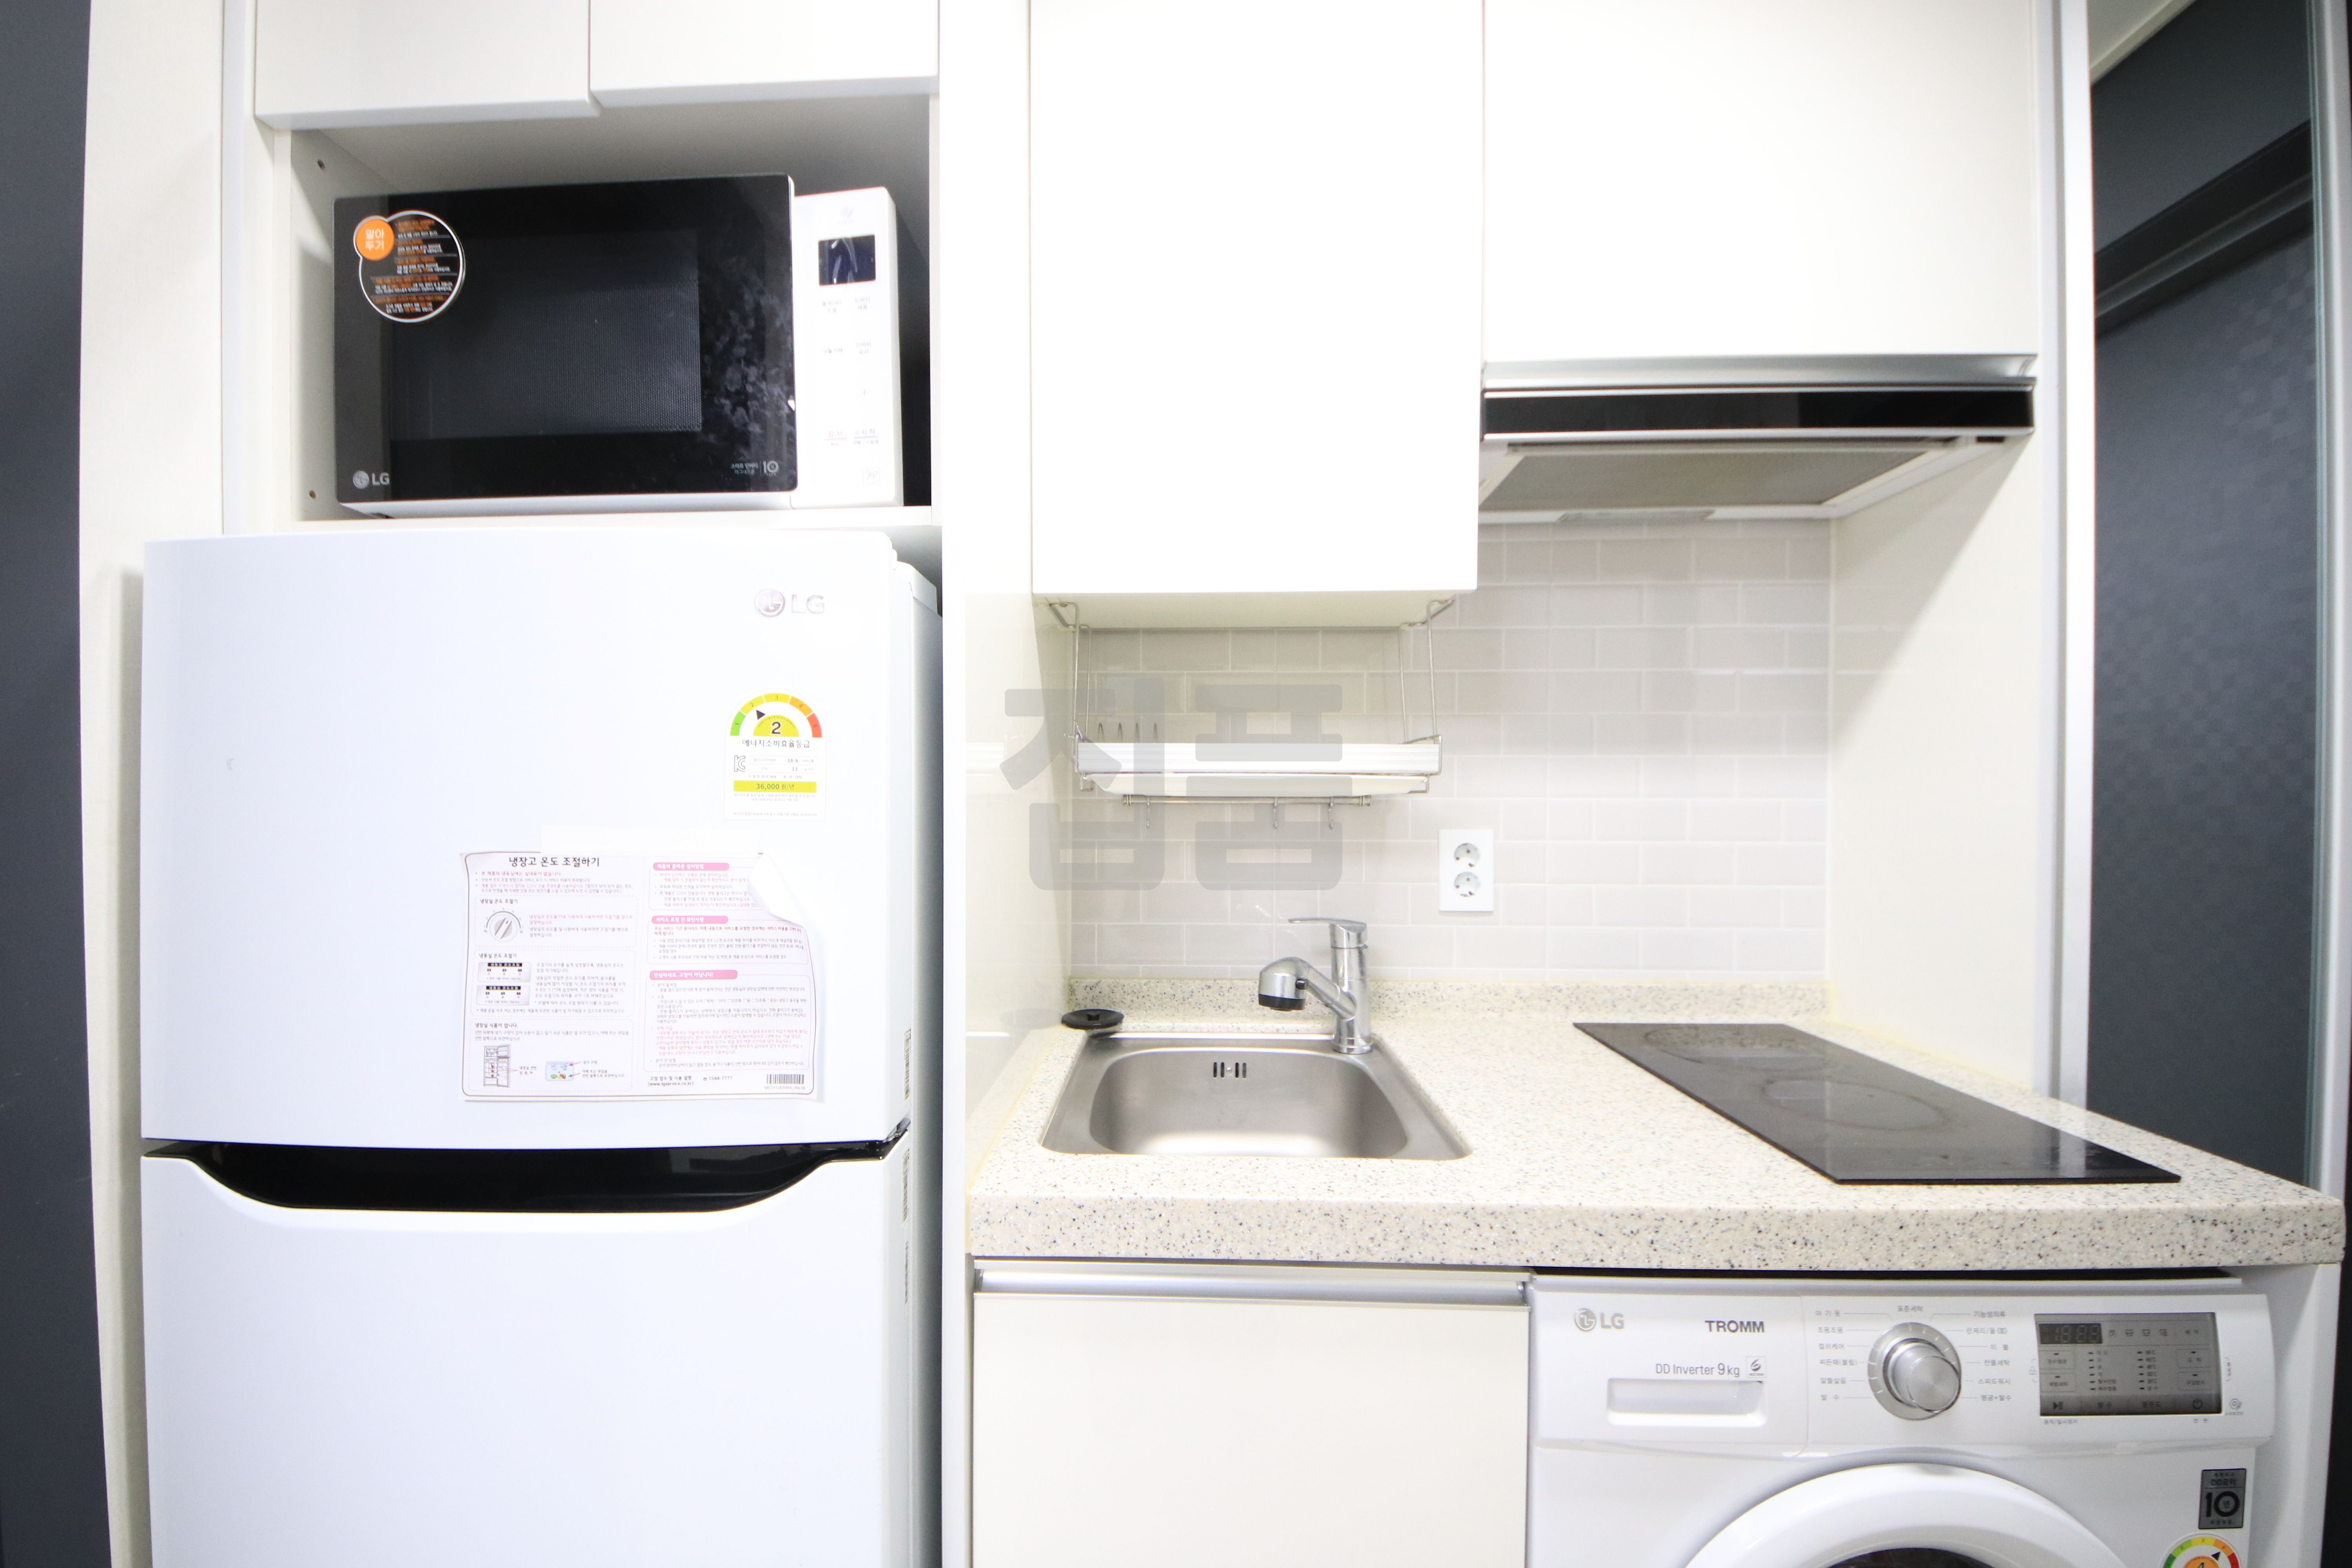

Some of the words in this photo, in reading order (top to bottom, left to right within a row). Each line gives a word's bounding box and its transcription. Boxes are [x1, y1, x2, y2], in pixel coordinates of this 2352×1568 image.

[372, 473, 390, 485] LG
[791, 594, 824, 613] LG
[771, 721, 781, 734] 2
[742, 739, 809, 748] 에너지소비효율등급
[509, 857, 536, 867] 냉장고
[540, 857, 558, 867] 온도
[562, 857, 599, 867] 조절하기
[1601, 1312, 1624, 1329] LG
[1705, 1320, 1765, 1333] TROMM
[1655, 1363, 1670, 1374] DD
[1673, 1364, 1714, 1375] Inverter
[2205, 1491, 2240, 1517] 10
